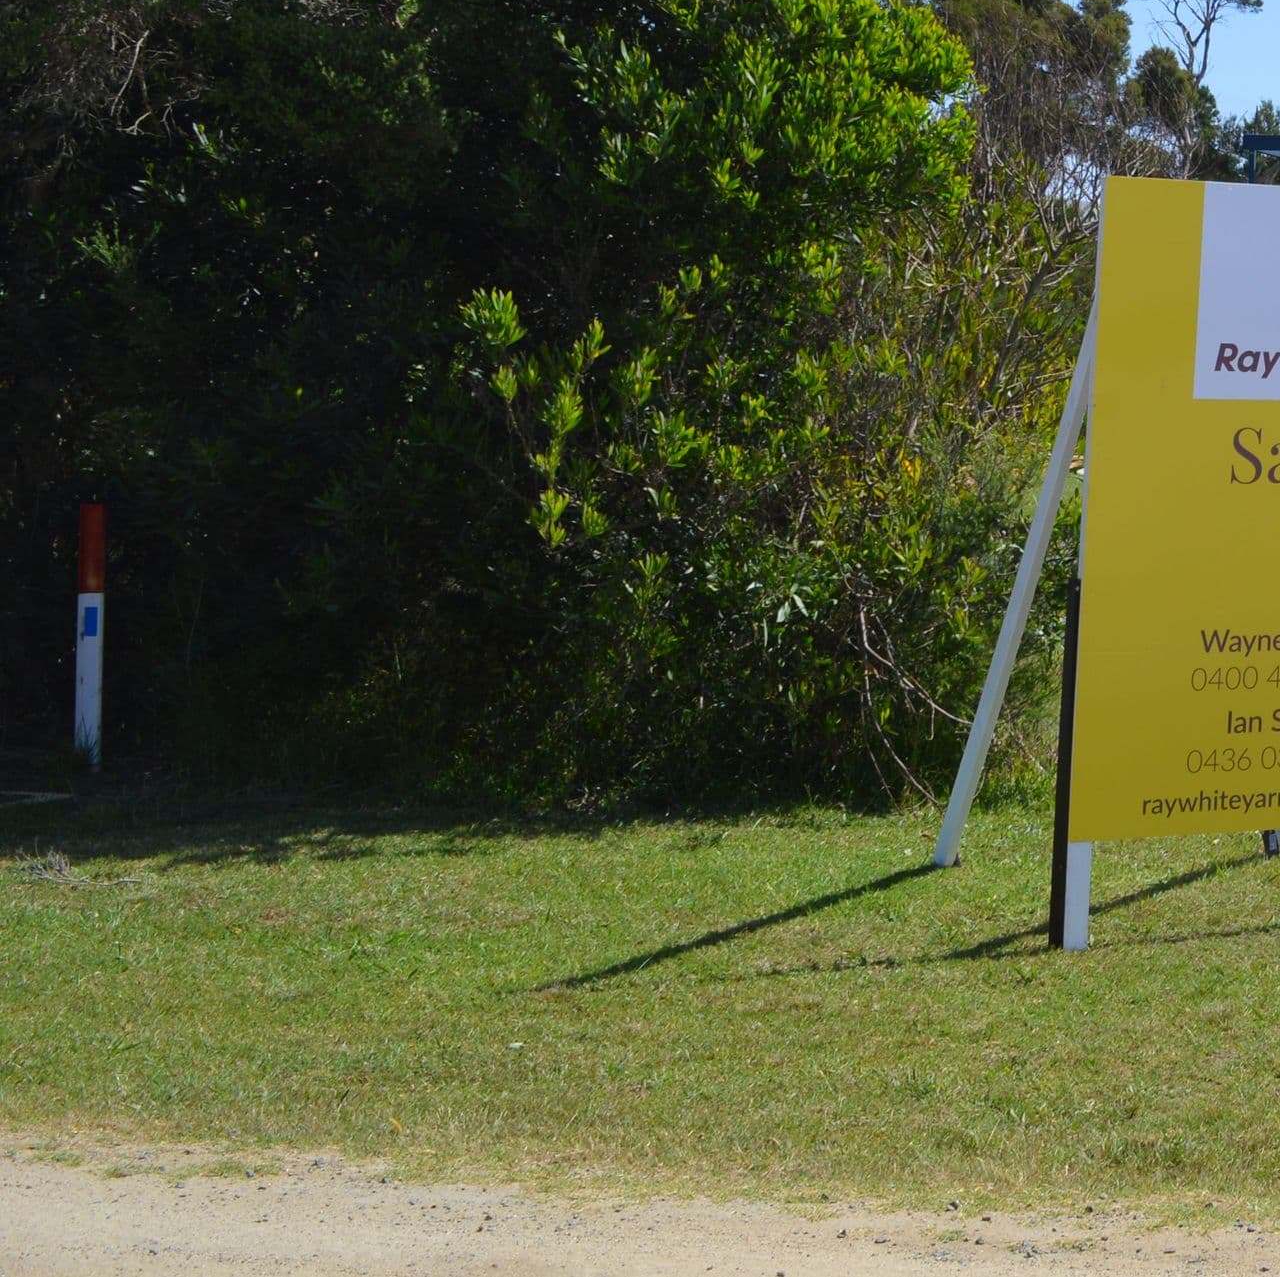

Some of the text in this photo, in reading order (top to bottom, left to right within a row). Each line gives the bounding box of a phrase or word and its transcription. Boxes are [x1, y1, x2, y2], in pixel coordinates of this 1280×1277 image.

[1190, 665, 1259, 692] 0400
[1227, 710, 1263, 735] Ian
[1186, 747, 1252, 774] 0436
